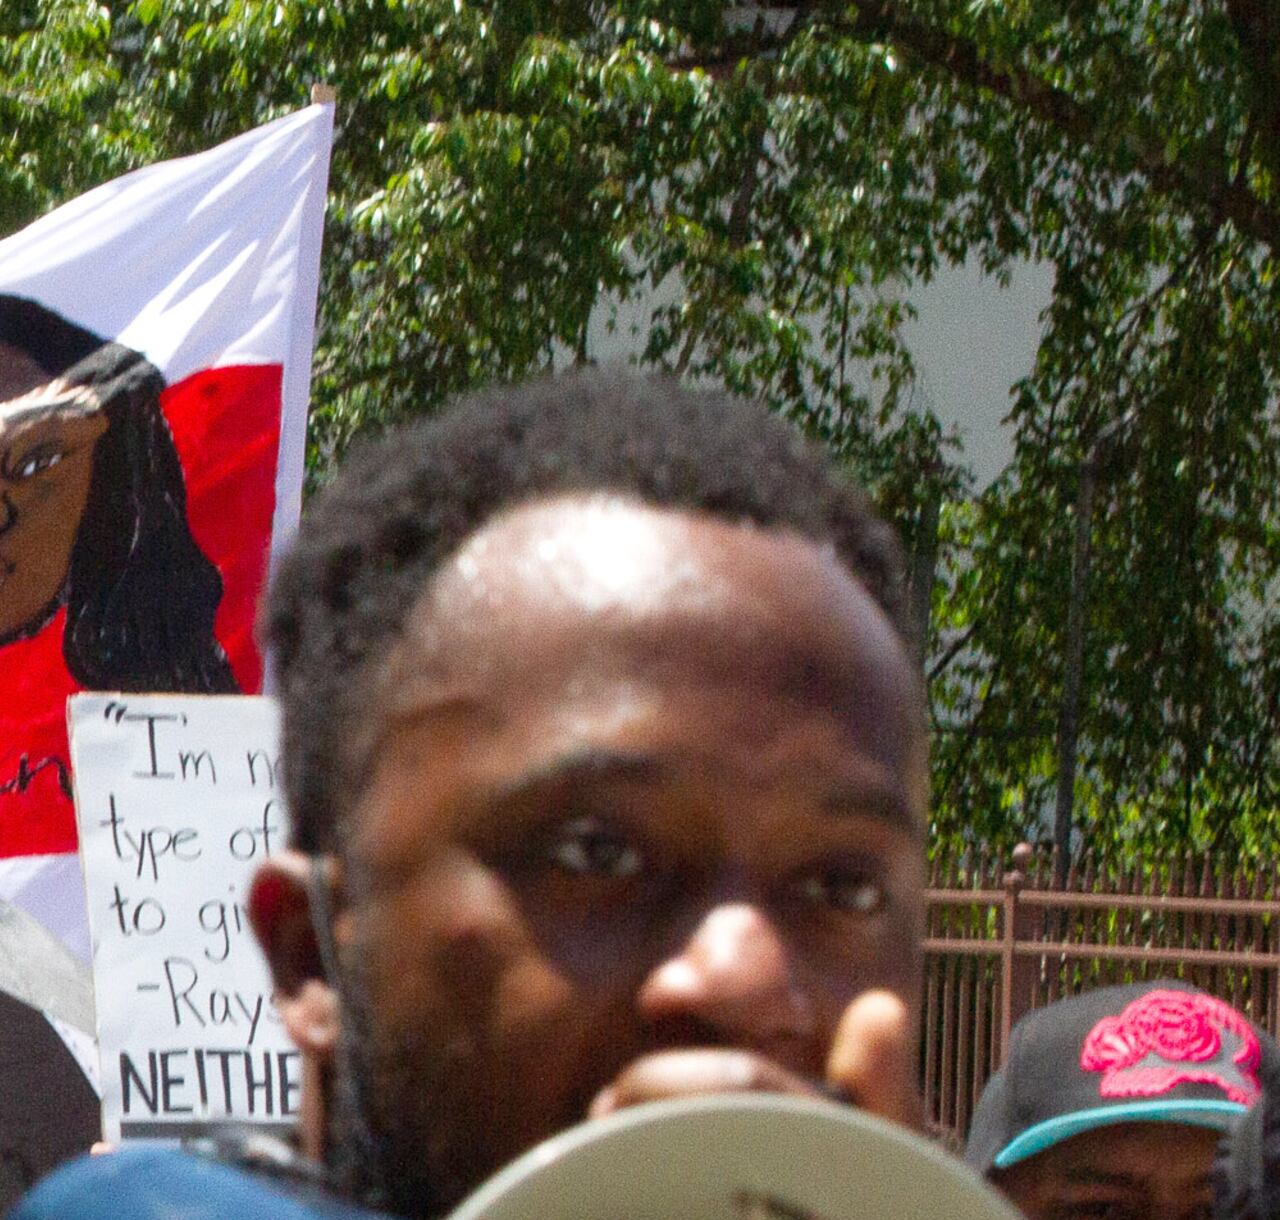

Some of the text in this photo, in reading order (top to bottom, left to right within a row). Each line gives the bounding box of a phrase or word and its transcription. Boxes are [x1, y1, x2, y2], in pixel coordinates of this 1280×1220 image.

[100, 793, 280, 881] type of
[110, 884, 242, 962] to gi
[119, 1047, 301, 1116] NEITHE
